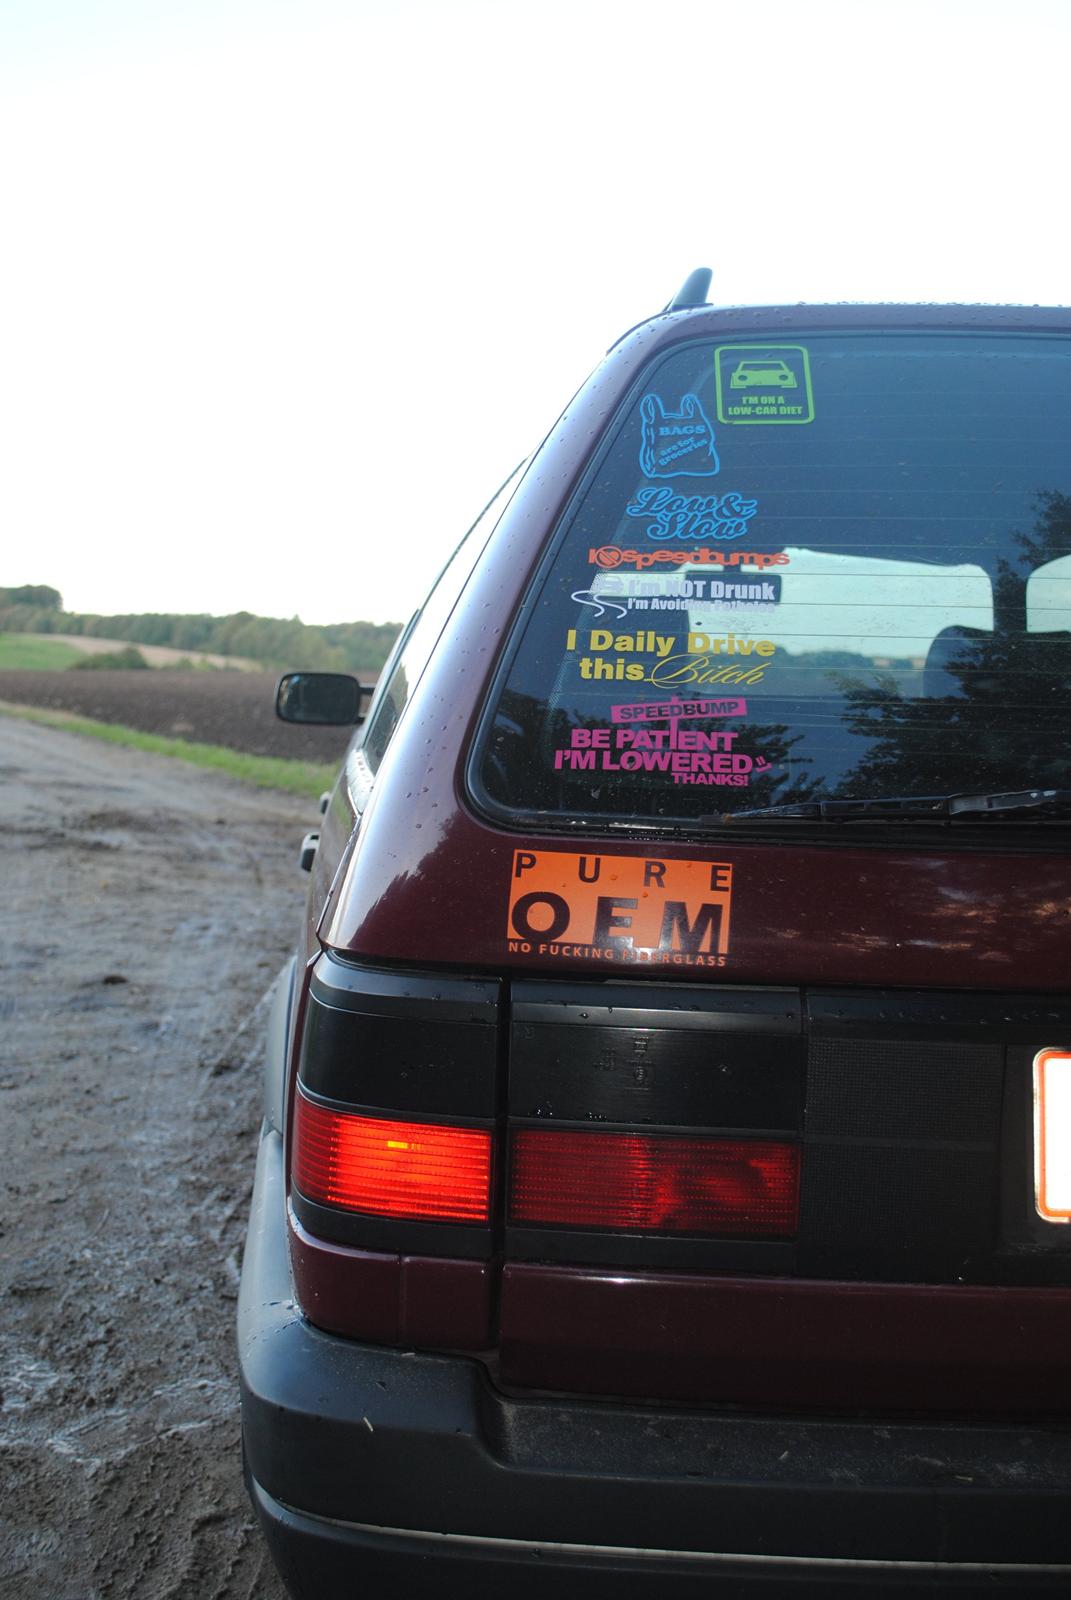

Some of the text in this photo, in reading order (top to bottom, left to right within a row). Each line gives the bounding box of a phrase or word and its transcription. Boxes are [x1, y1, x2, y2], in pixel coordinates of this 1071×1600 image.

[728, 406, 803, 416] LOW-CAR DIET
[742, 395, 785, 405] I'M ON A
[658, 425, 706, 436] BAGS
[626, 487, 758, 521] Low &
[647, 512, 748, 540] Slow
[588, 548, 790, 570] I speedbumps
[629, 579, 775, 600] I'm NOT Drunk
[627, 598, 649, 610] I'm
[651, 598, 711, 613] Avoiding
[566, 629, 777, 658] I Daily Drive
[579, 653, 772, 689] this Bitch
[620, 701, 739, 720] SPEEDBUMP
[571, 727, 739, 751] BE PATIENT
[554, 750, 753, 773] I'M LOWERED
[671, 772, 749, 787] THANKS!
[514, 852, 731, 892] PURE
[511, 891, 724, 952] OEM
[508, 941, 727, 967] NO FUCKING FIBERGLASS
